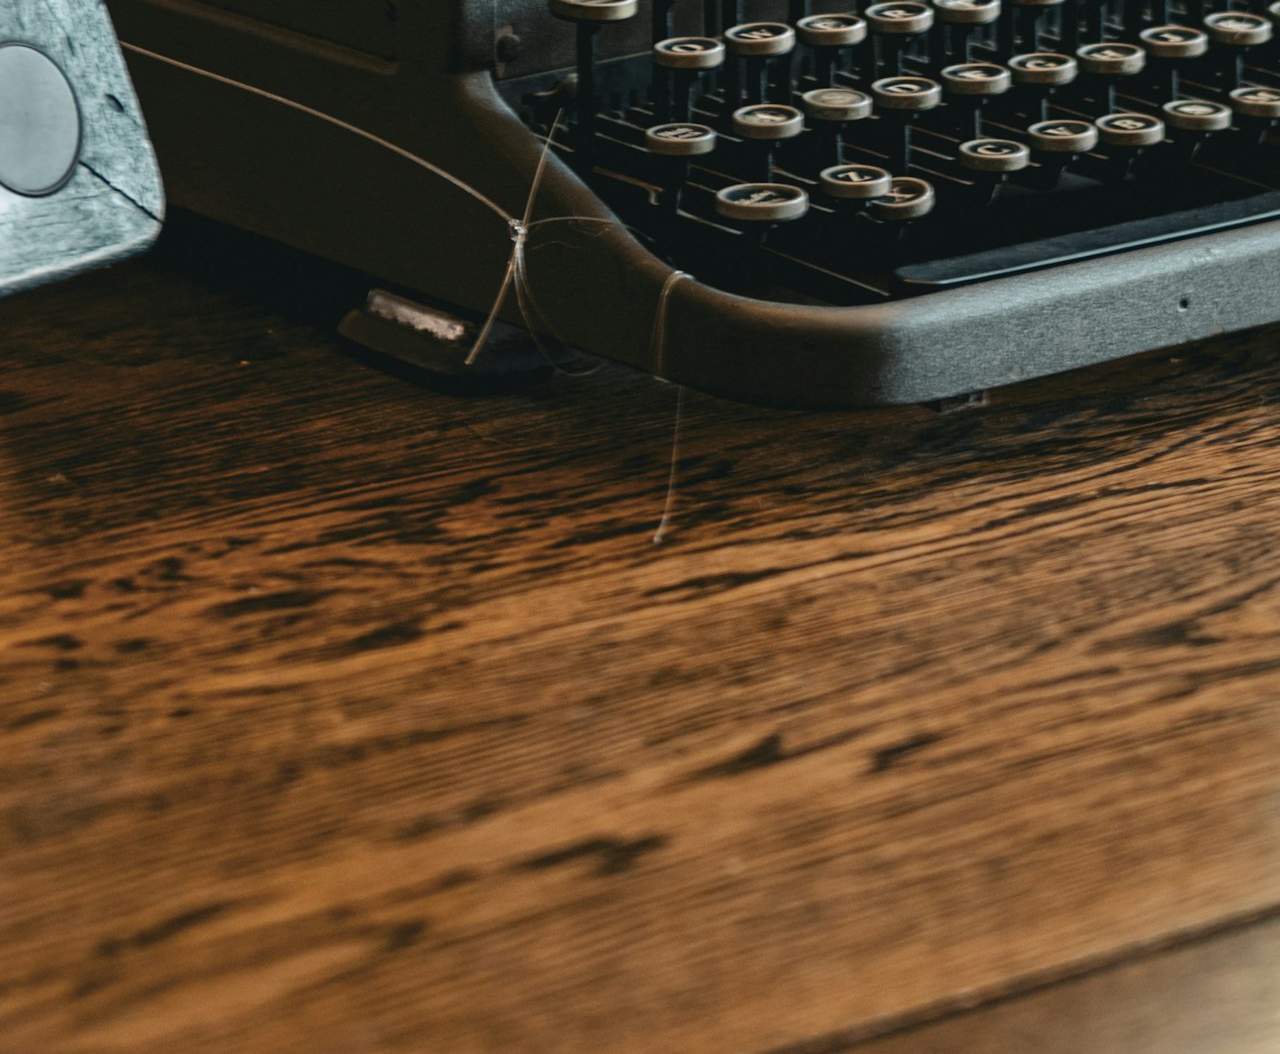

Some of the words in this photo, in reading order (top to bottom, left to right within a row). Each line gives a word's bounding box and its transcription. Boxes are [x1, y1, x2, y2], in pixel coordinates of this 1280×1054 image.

[1109, 118, 1147, 130] B
[976, 143, 1011, 155] C
[837, 171, 872, 183] Z
